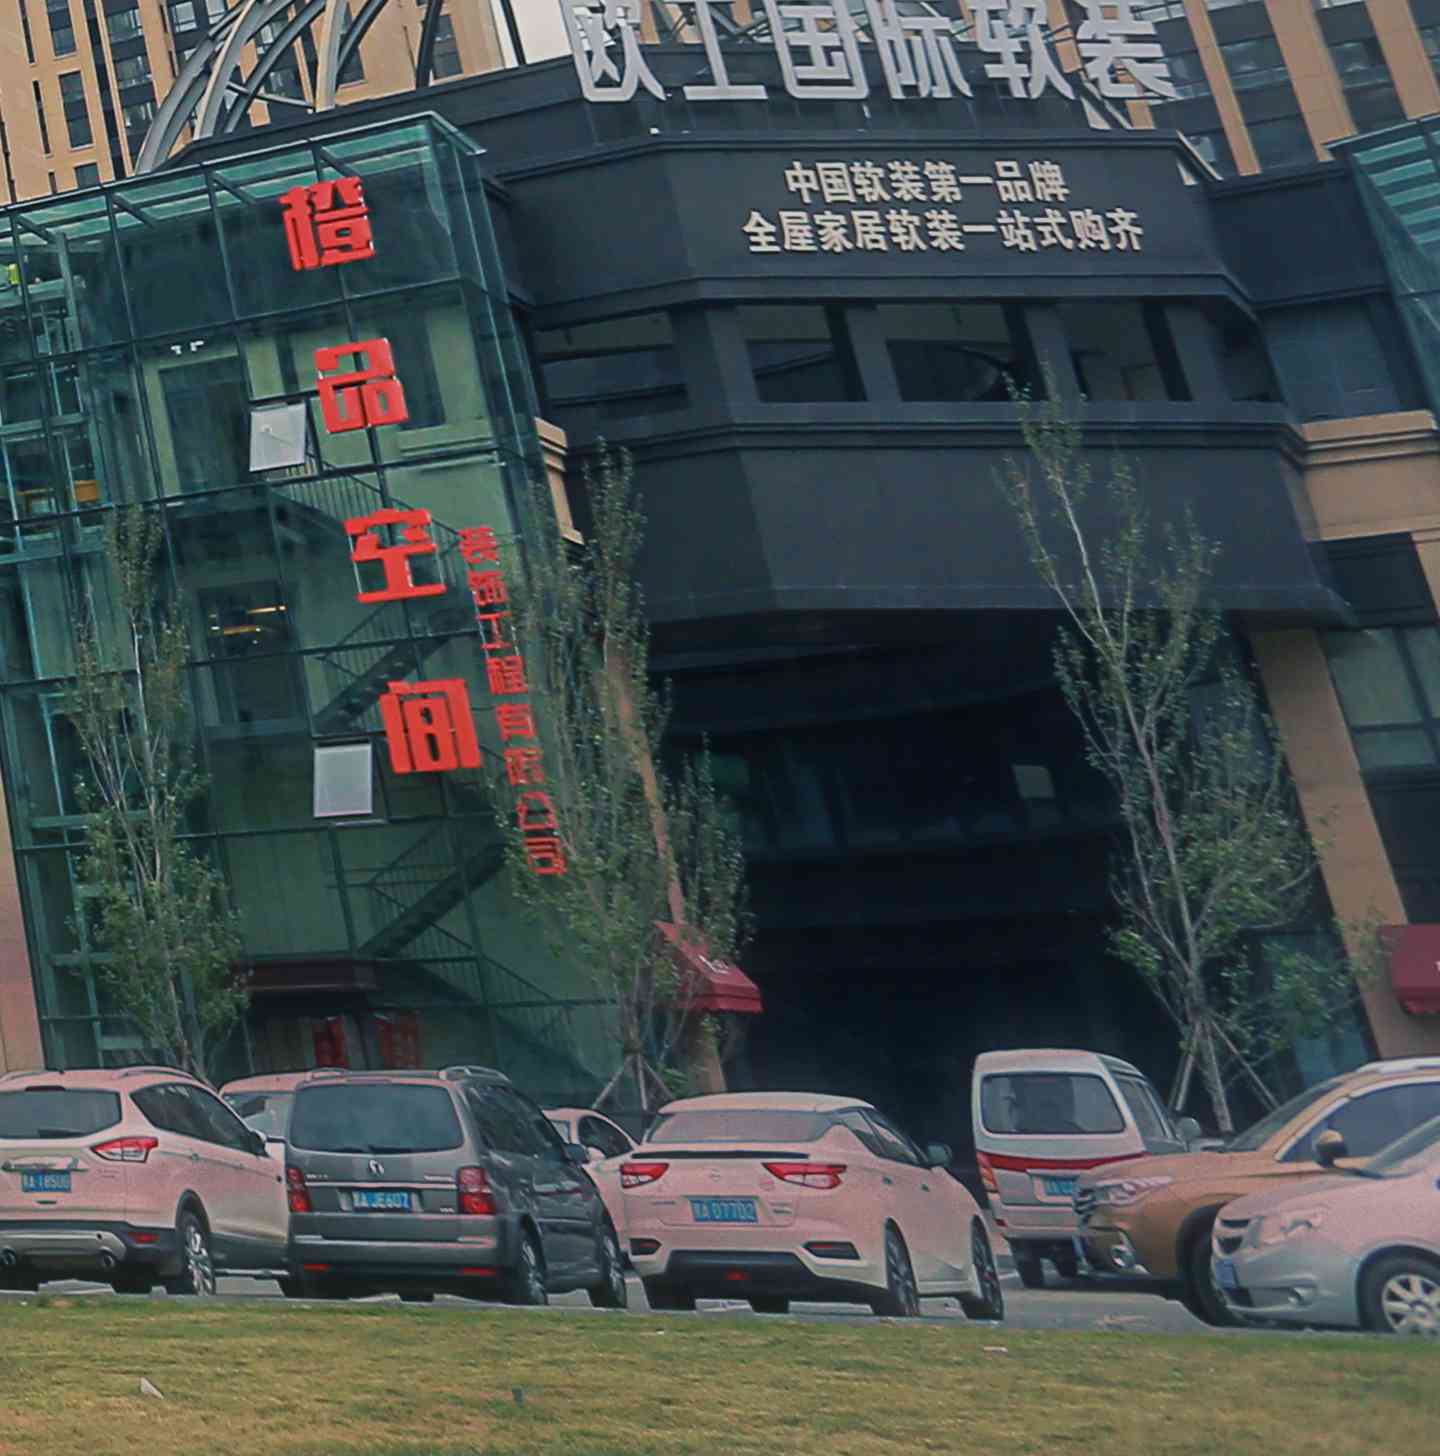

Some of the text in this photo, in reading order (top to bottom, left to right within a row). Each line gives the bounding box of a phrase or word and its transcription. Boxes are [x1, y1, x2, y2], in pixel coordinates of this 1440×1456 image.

[783, 160, 1071, 204] 中国软装第一品牌
[742, 207, 1144, 252] 全屋家居软装一站式购齐
[280, 176, 481, 775] 橙品空间
